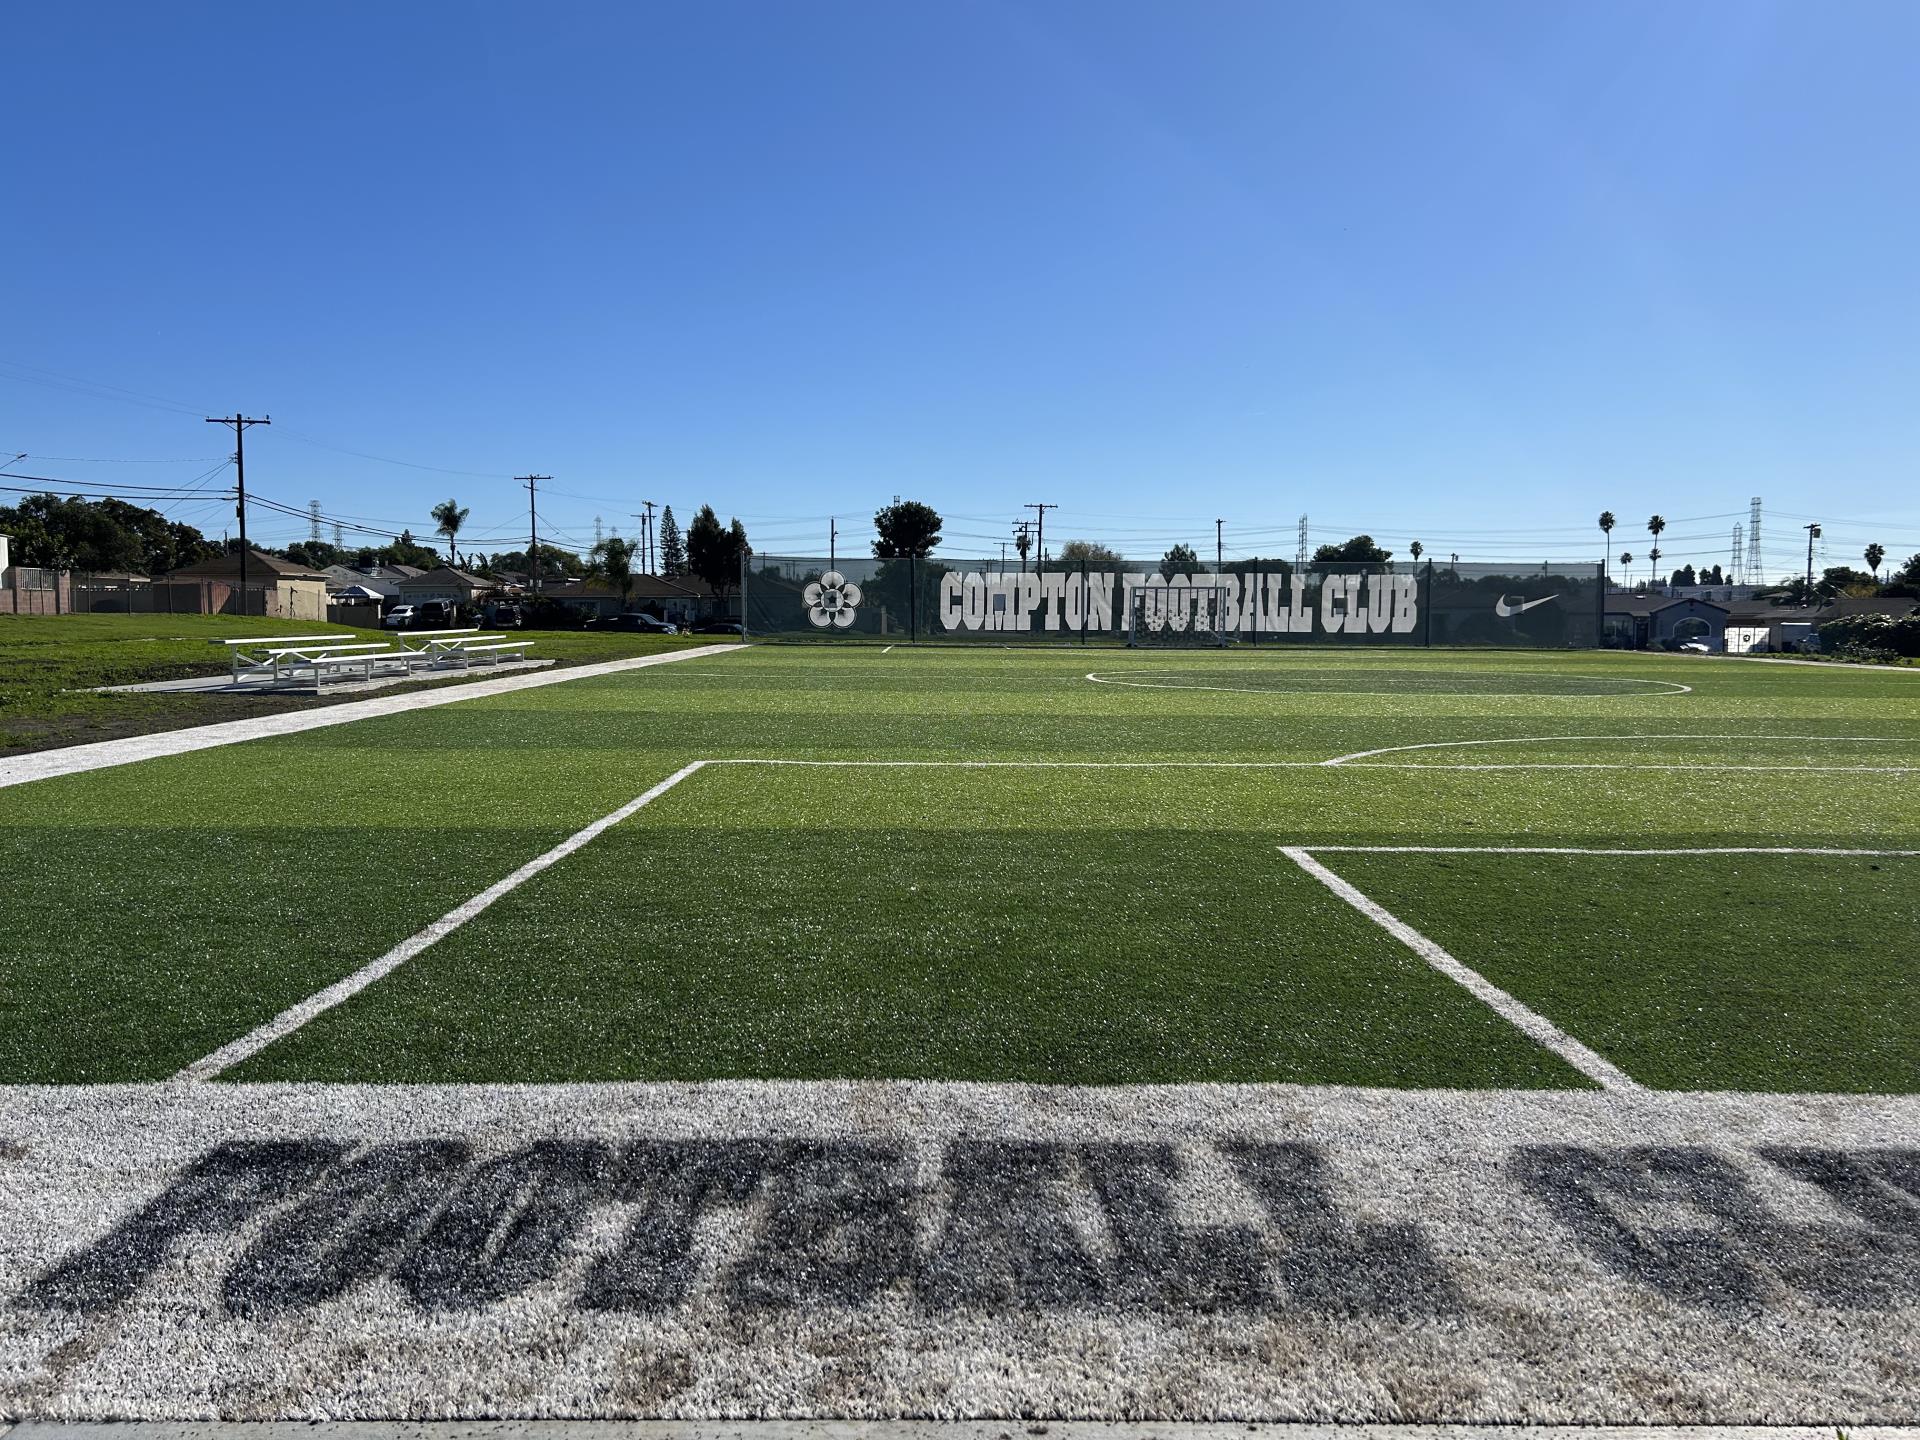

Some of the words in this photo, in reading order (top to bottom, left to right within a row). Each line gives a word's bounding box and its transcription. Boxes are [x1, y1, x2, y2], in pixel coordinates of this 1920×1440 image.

[940, 571, 1115, 631] COMPTON
[1121, 572, 1313, 633] FOOTBALL
[1320, 573, 1418, 634] CLUB
